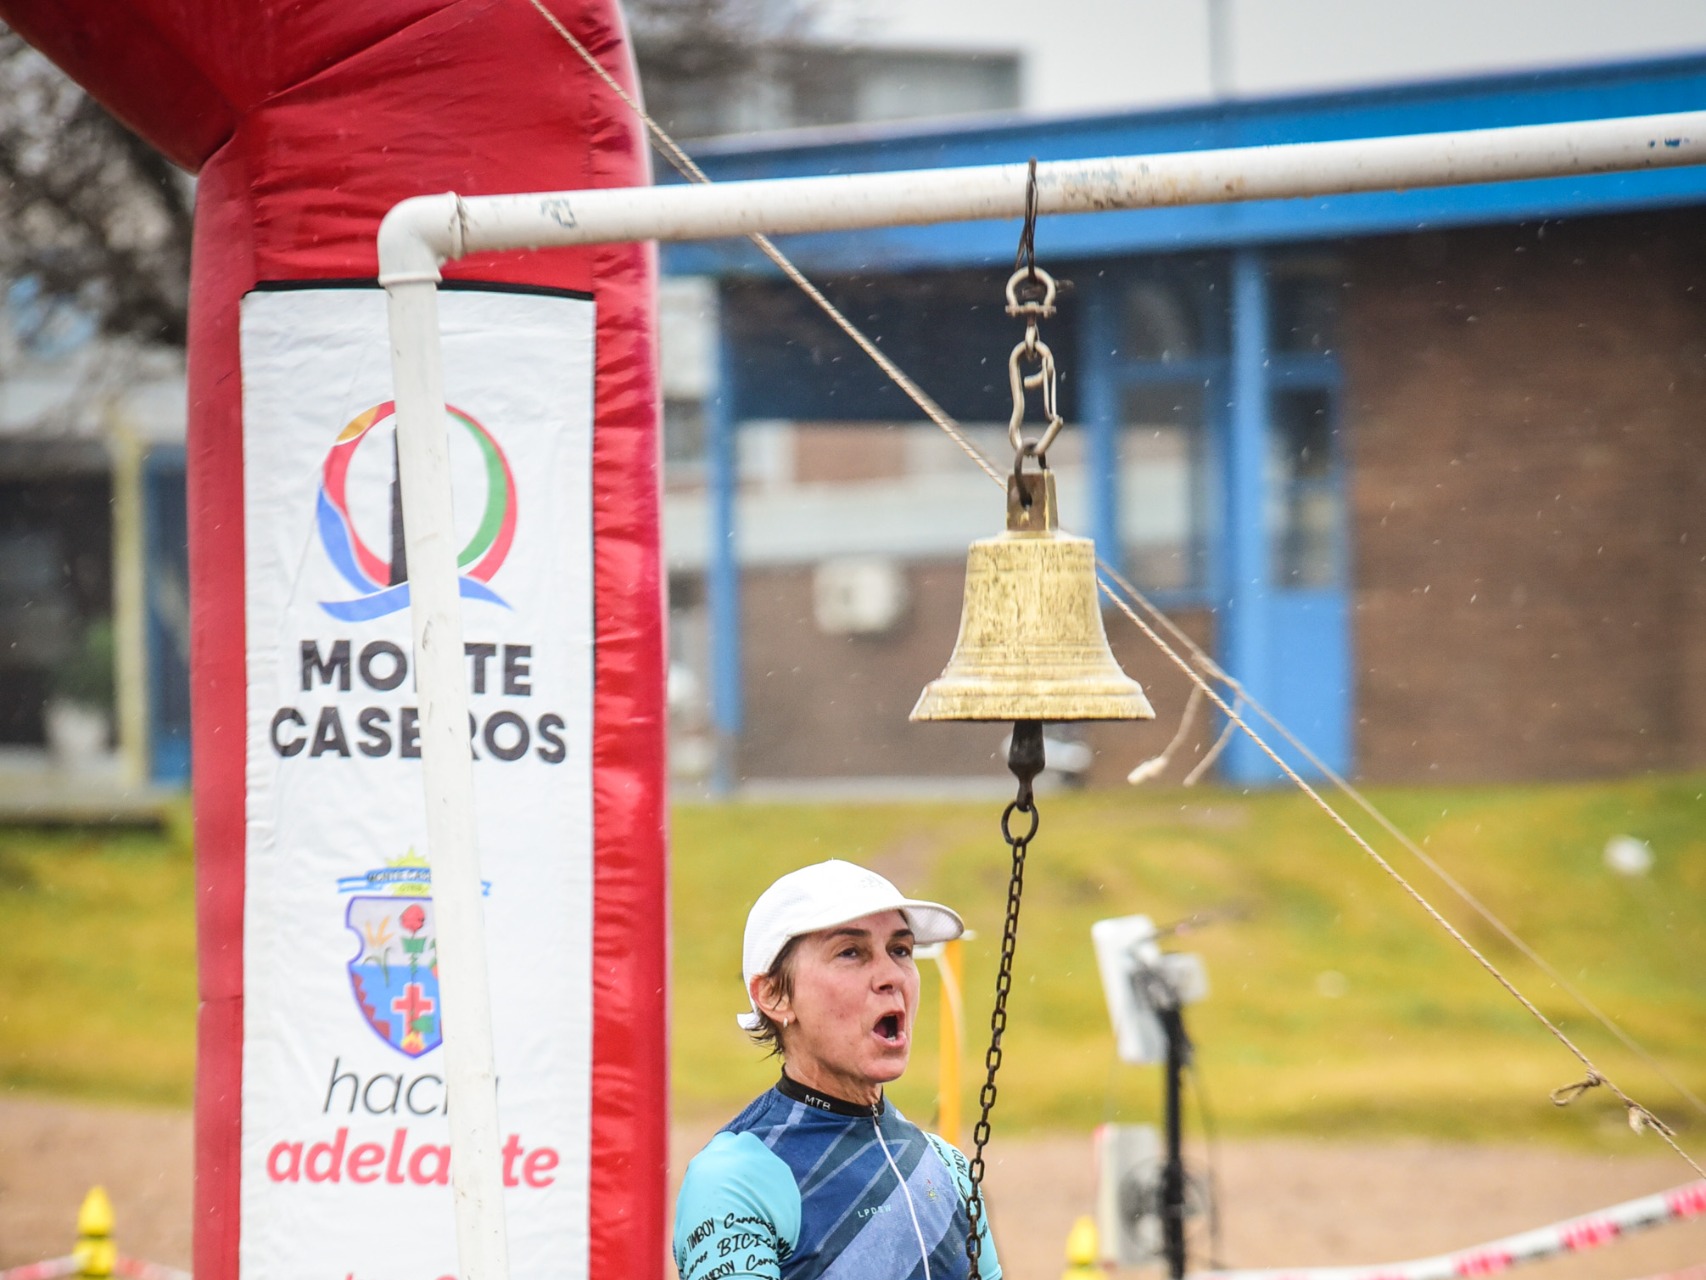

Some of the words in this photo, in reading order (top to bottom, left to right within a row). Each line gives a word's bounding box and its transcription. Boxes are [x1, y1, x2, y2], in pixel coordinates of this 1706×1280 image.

[300, 640, 532, 696] MOTE
[804, 1094, 832, 1111] MTB
[266, 1127, 560, 1188] adelate
